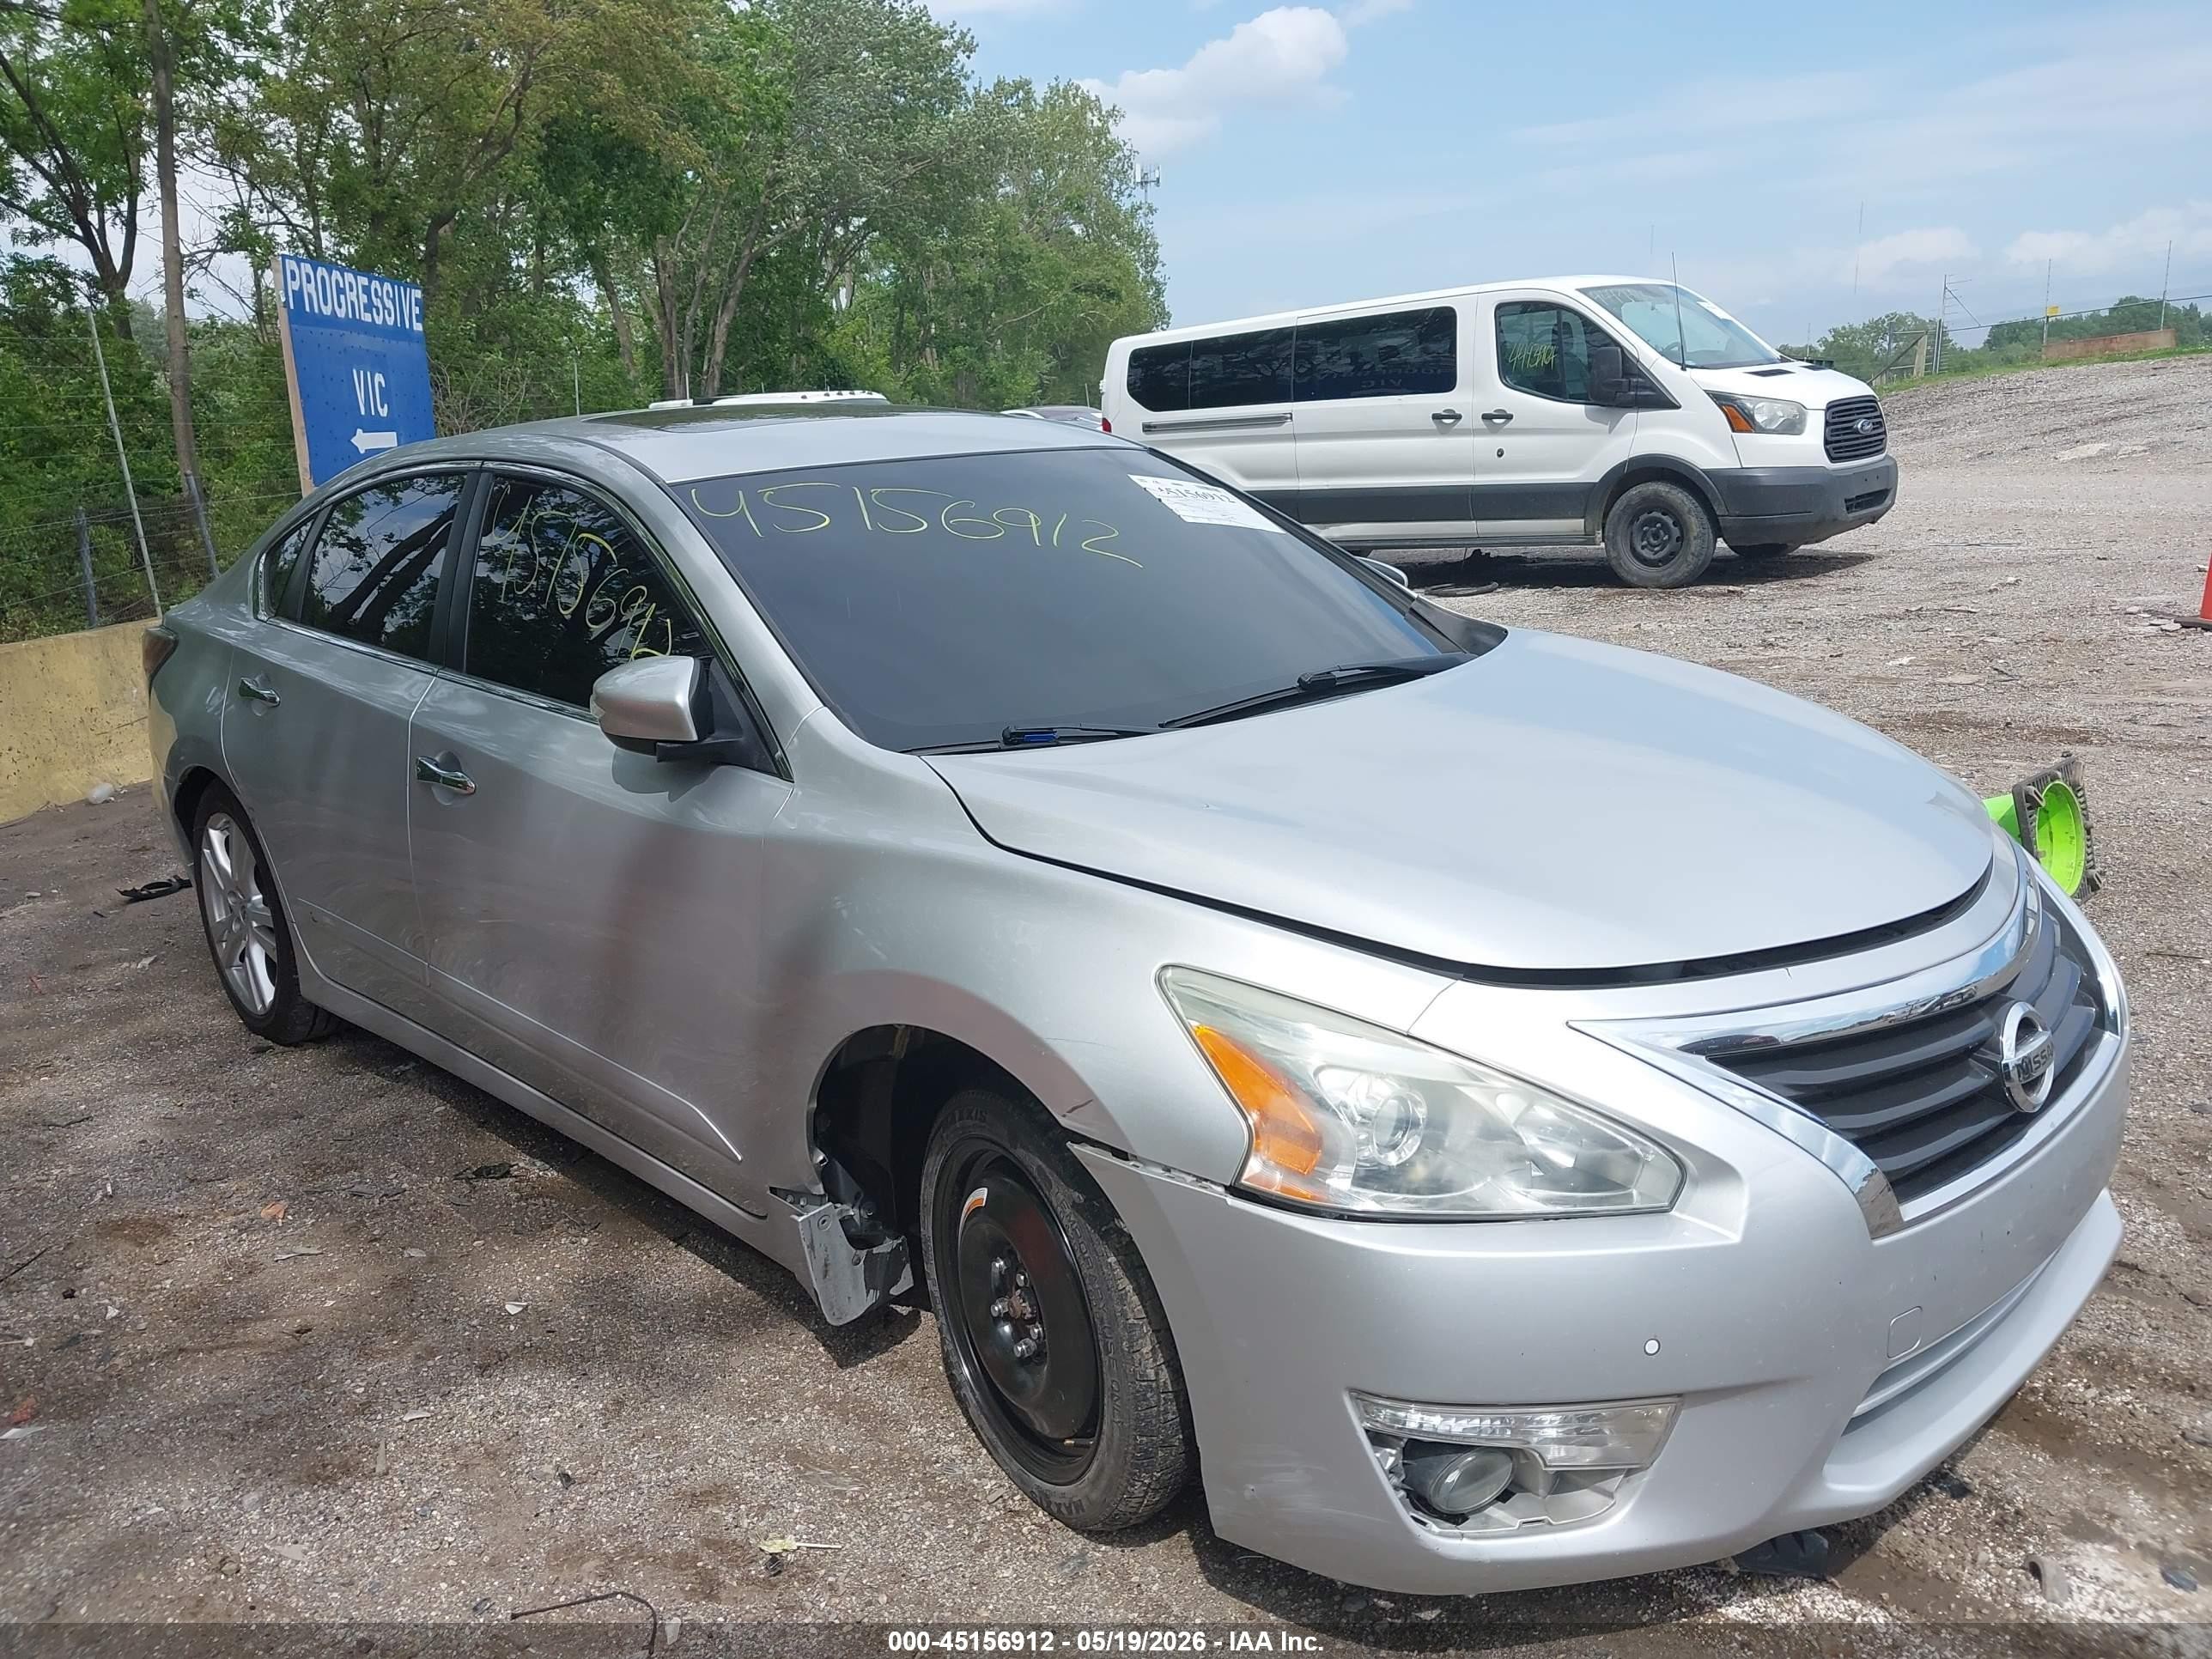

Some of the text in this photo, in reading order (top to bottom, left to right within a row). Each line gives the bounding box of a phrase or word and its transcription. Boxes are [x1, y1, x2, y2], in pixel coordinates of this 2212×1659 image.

[285, 258, 423, 331] PROGRESSIVE
[352, 368, 388, 417] VIC
[690, 482, 1145, 568] 45156912
